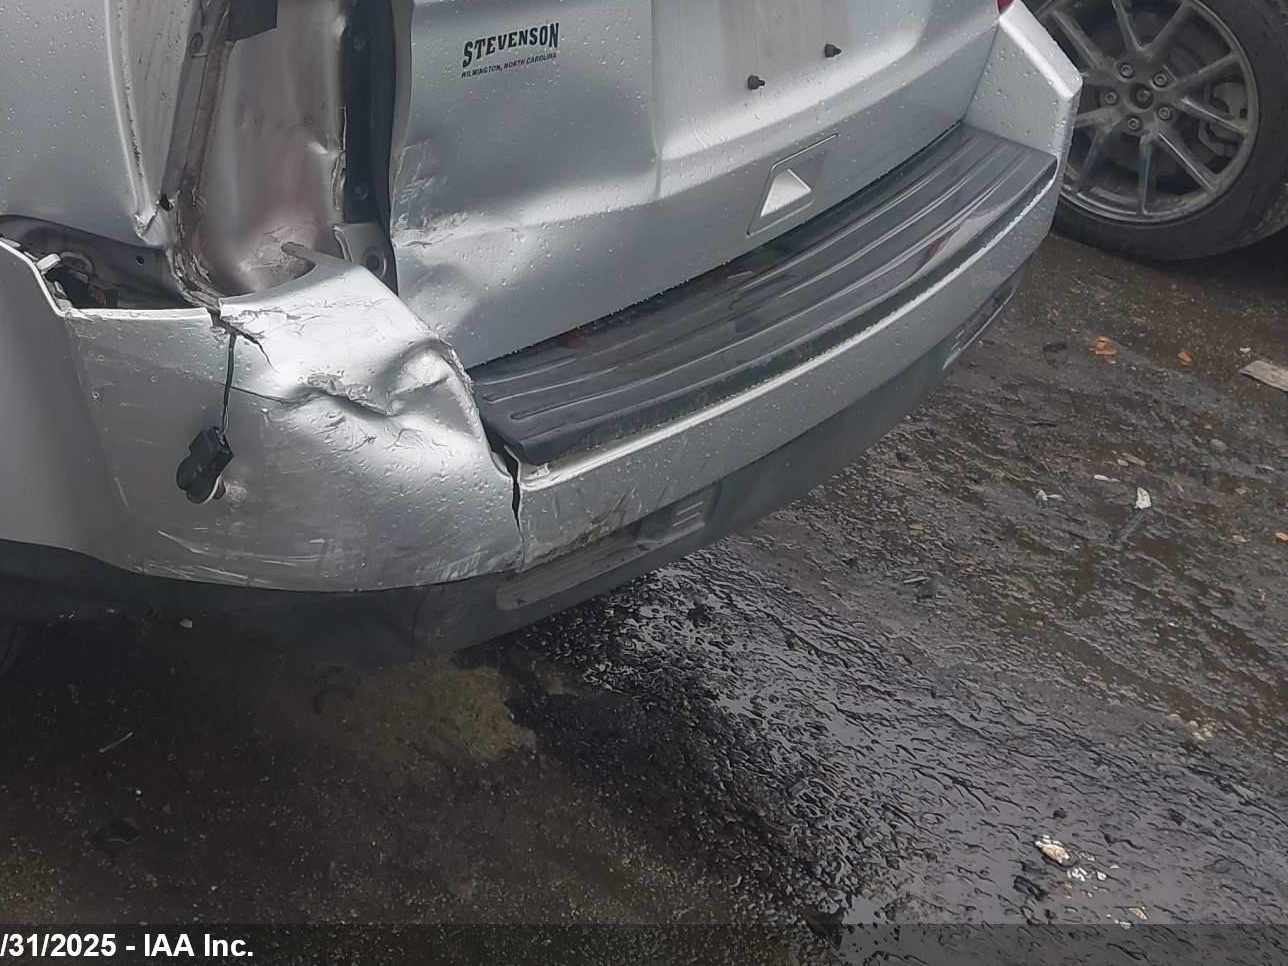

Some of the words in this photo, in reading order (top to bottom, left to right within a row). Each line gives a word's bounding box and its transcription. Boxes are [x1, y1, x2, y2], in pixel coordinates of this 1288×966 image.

[462, 22, 560, 68] STEVENSON
[461, 64, 503, 79] WILMINGTON,
[503, 59, 525, 69] NORTH
[526, 52, 557, 64] CAROLINA
